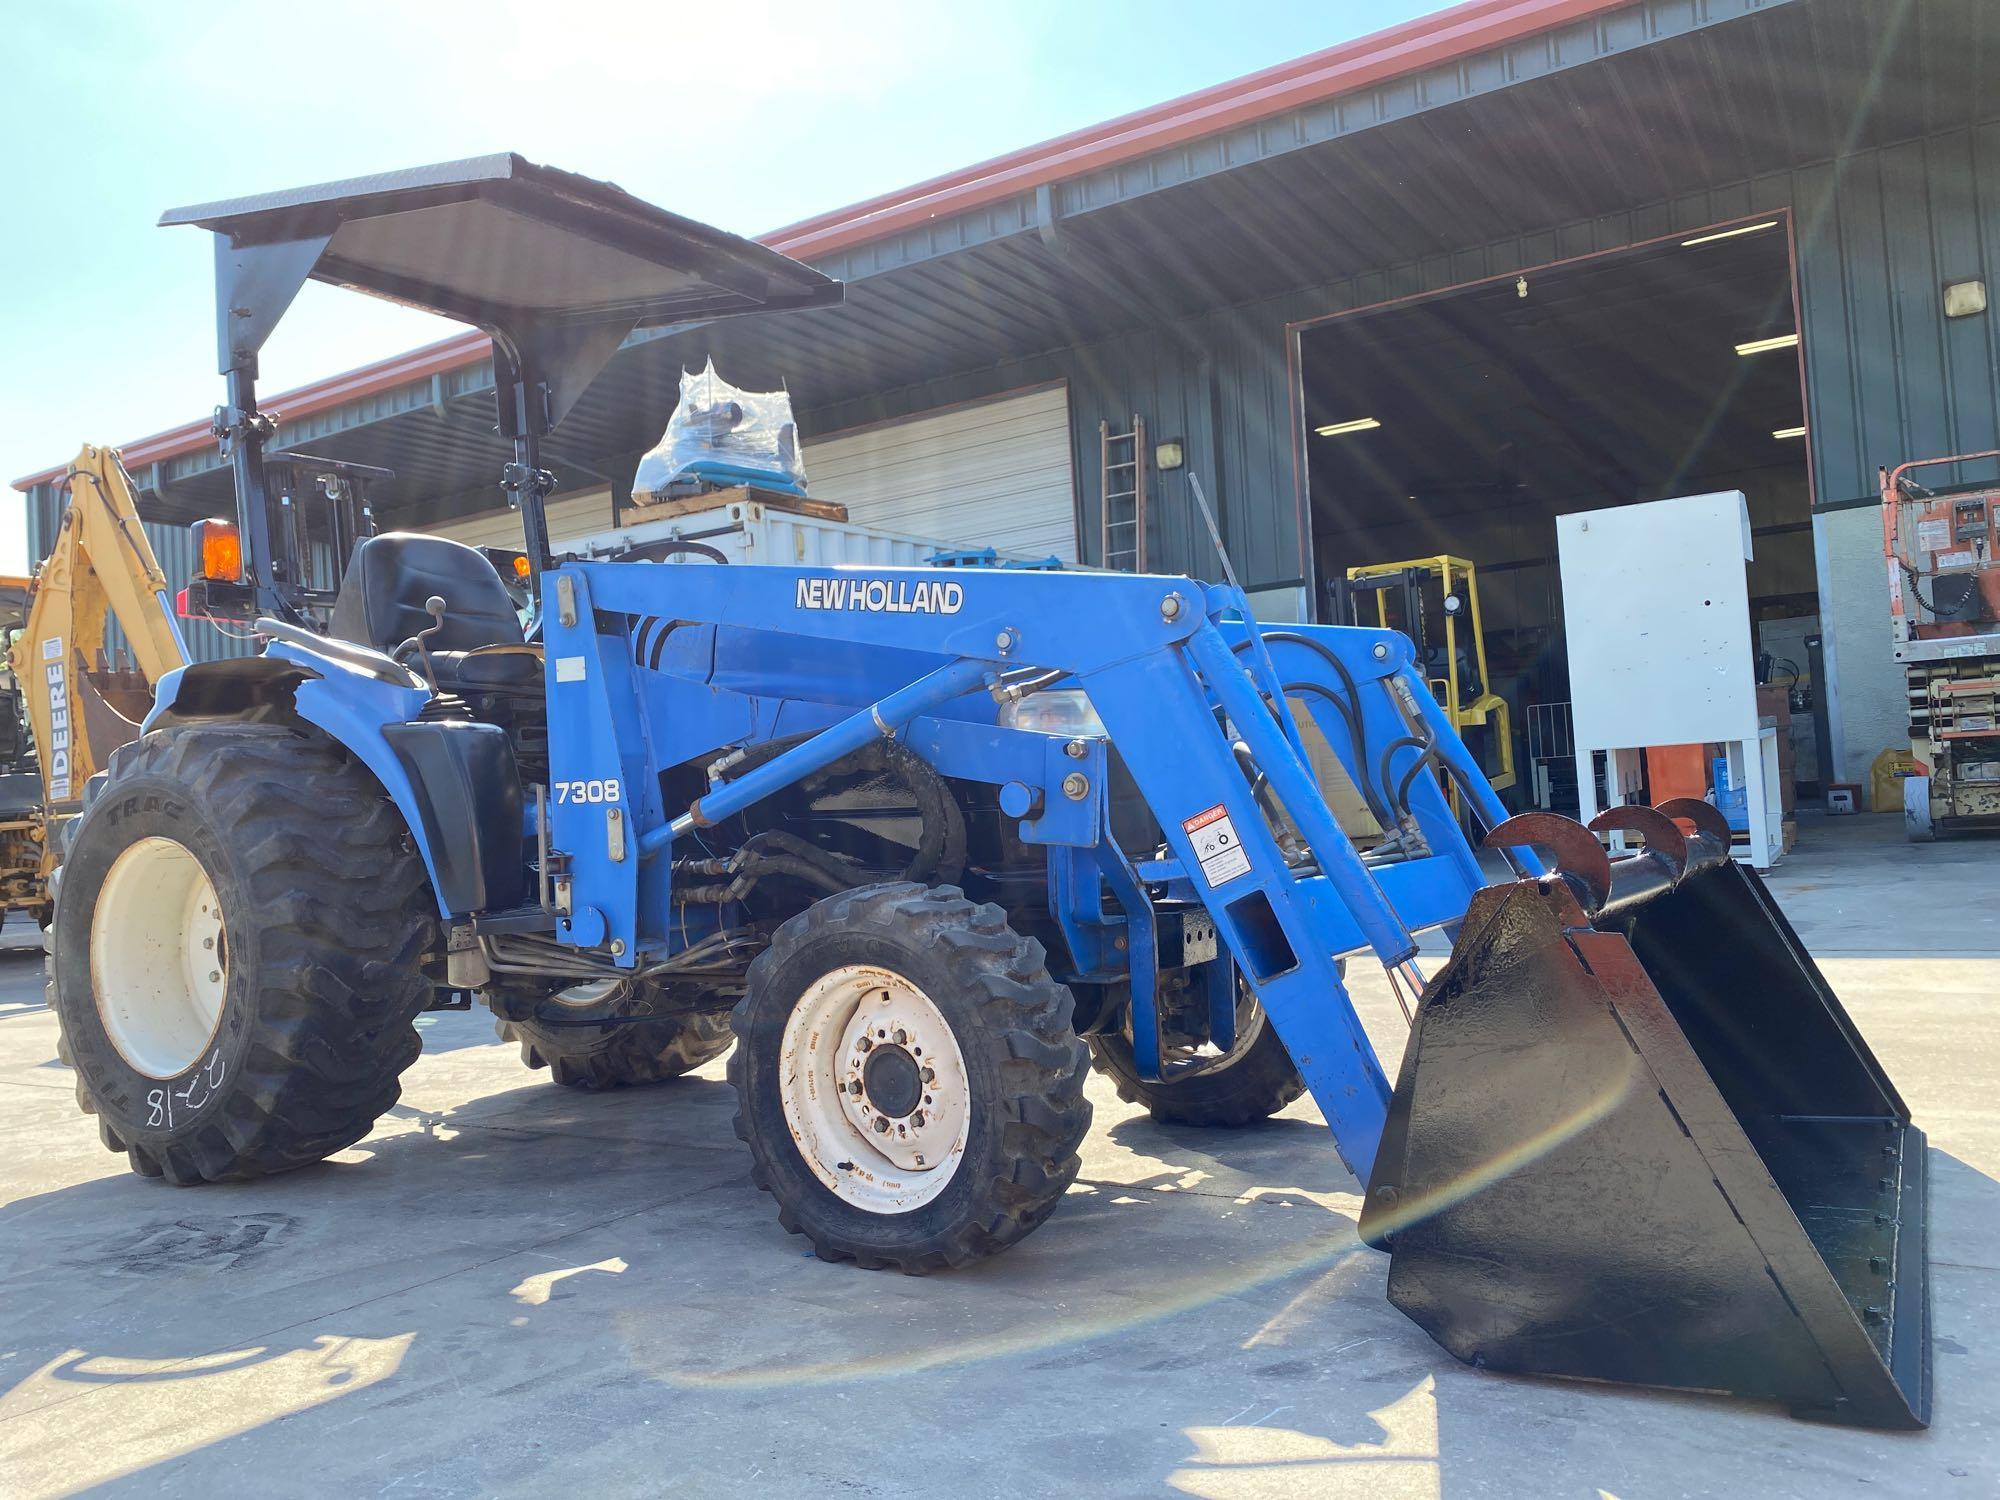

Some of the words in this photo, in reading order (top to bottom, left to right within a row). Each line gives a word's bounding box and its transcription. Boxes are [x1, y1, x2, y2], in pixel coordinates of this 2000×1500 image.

[795, 578, 847, 610] NEW
[848, 579, 964, 615] HOLLAND
[47, 663, 69, 777] DEERE
[554, 779, 620, 805] 7308
[107, 796, 186, 826] TRAC
[1194, 808, 1223, 826] DANGER
